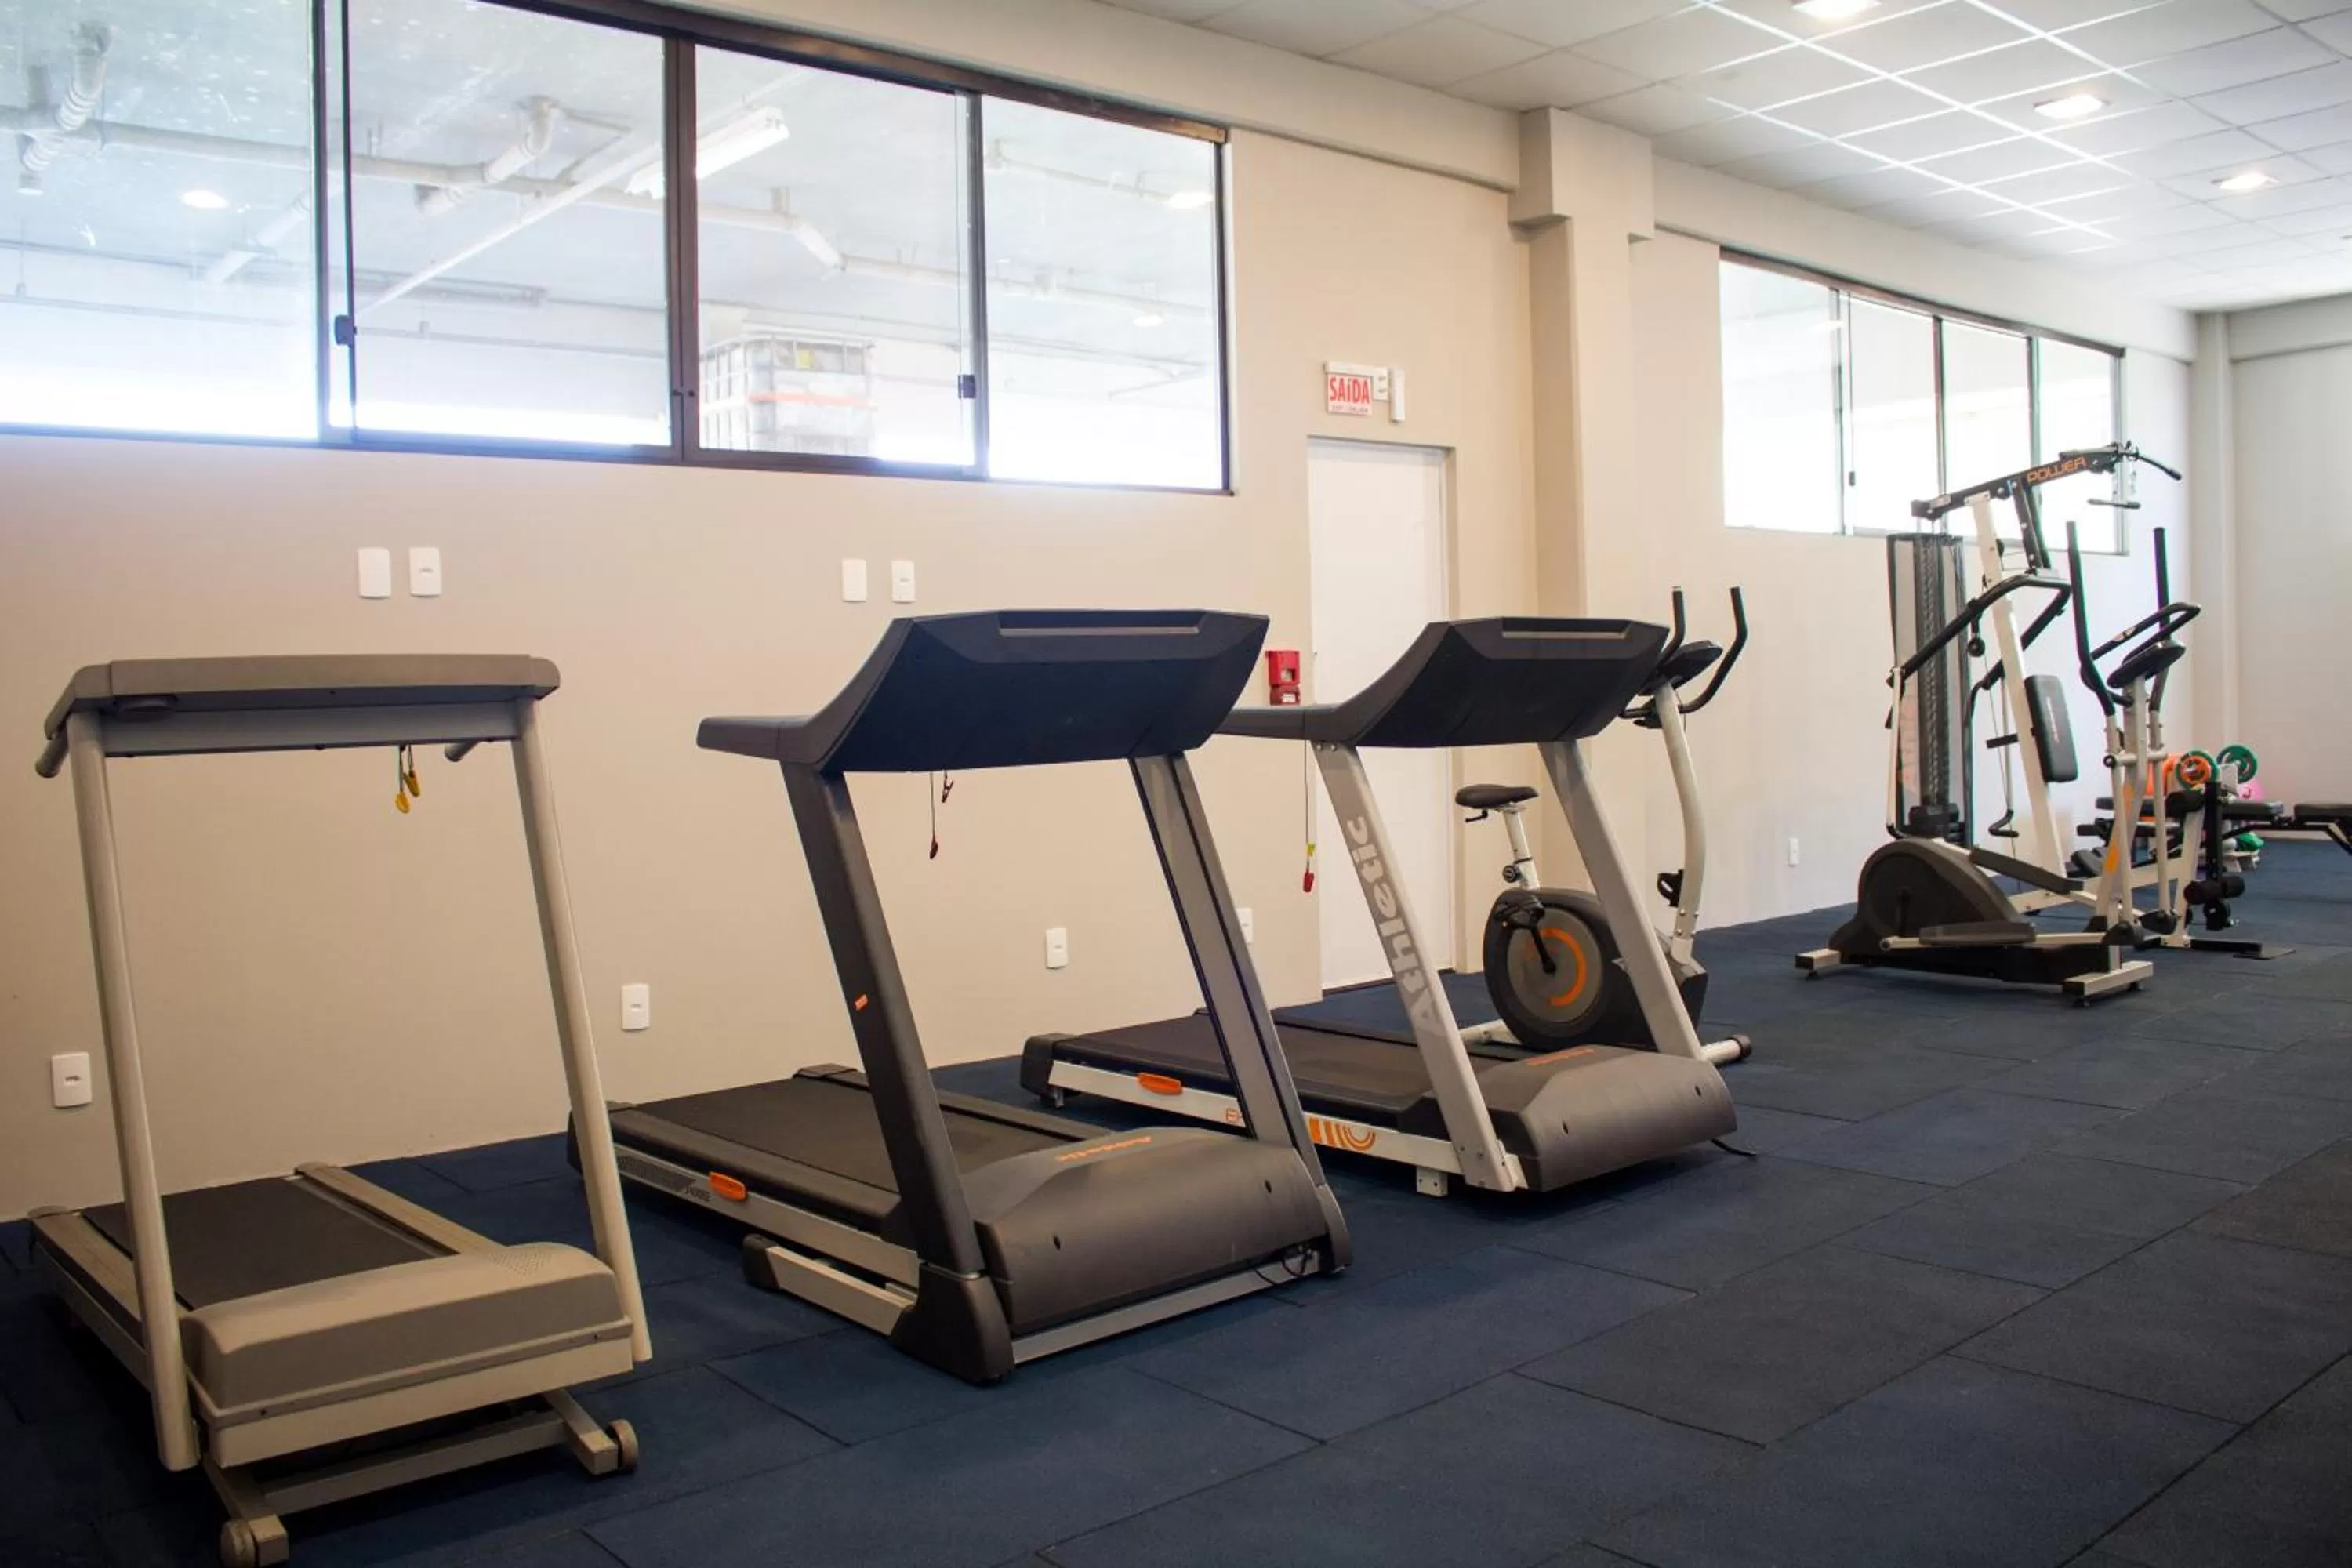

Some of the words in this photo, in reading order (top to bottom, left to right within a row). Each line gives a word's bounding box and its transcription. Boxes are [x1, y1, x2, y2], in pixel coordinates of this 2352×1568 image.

[1329, 376, 1370, 403] SAÍDA
[2027, 456, 2087, 482] POWER
[1348, 816, 1442, 1033] Athletic
